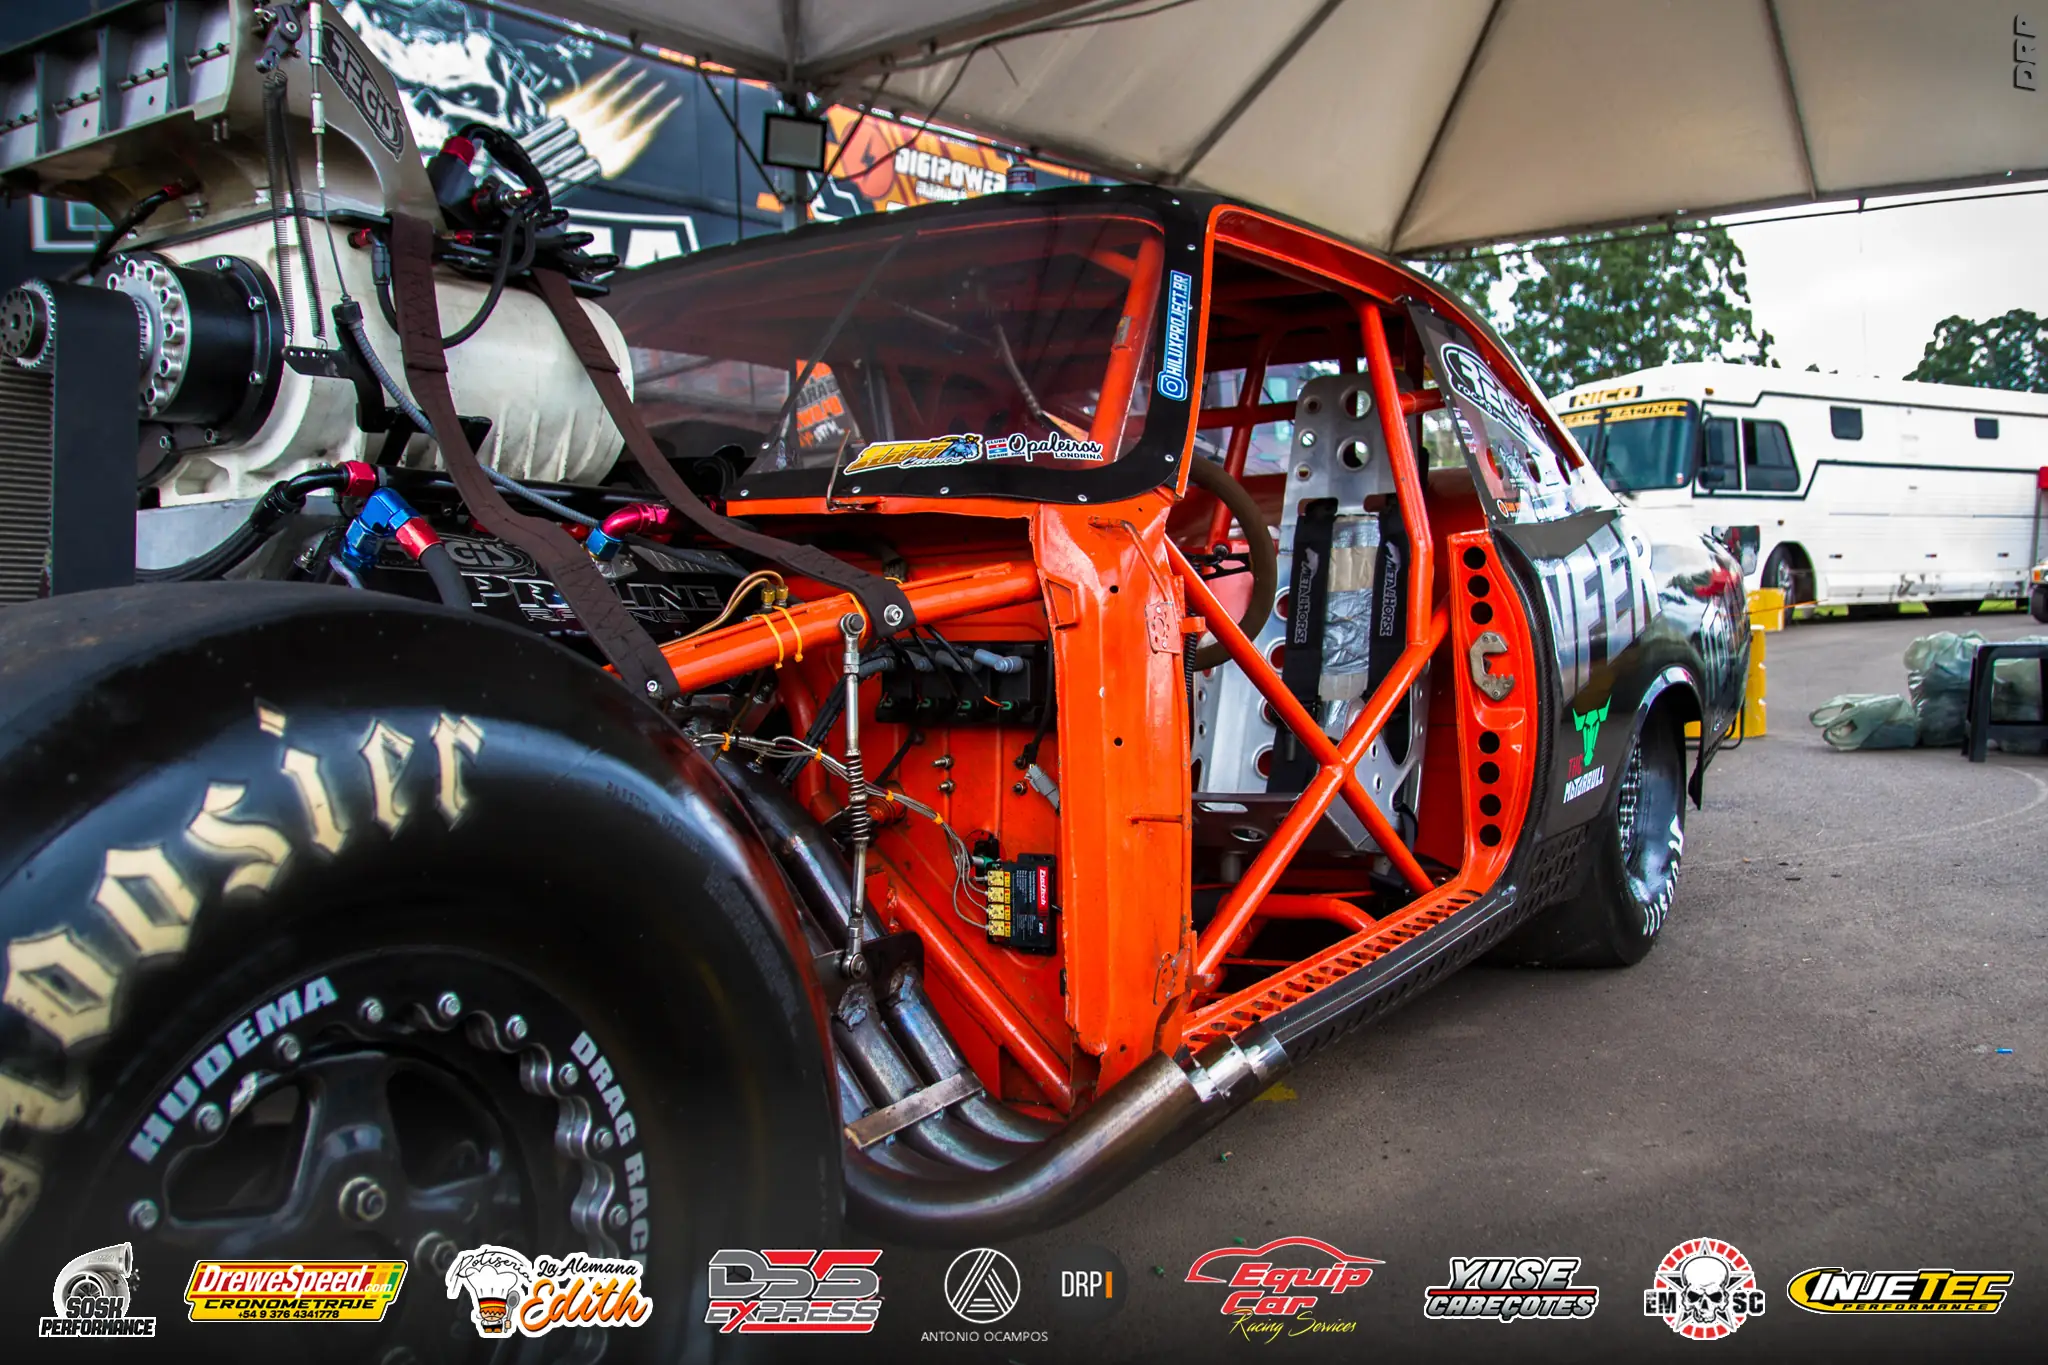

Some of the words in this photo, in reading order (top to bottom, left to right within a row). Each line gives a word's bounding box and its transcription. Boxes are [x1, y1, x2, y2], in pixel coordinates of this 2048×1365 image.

[1166, 273, 1188, 376] HILUXPROJECT.BR
[1573, 386, 1640, 408] NICO
[1008, 433, 1101, 461] Opaleiros
[1054, 452, 1102, 460] LONDRINA
[130, 975, 339, 1163] HUDEMA
[569, 1030, 637, 1147] DRAG
